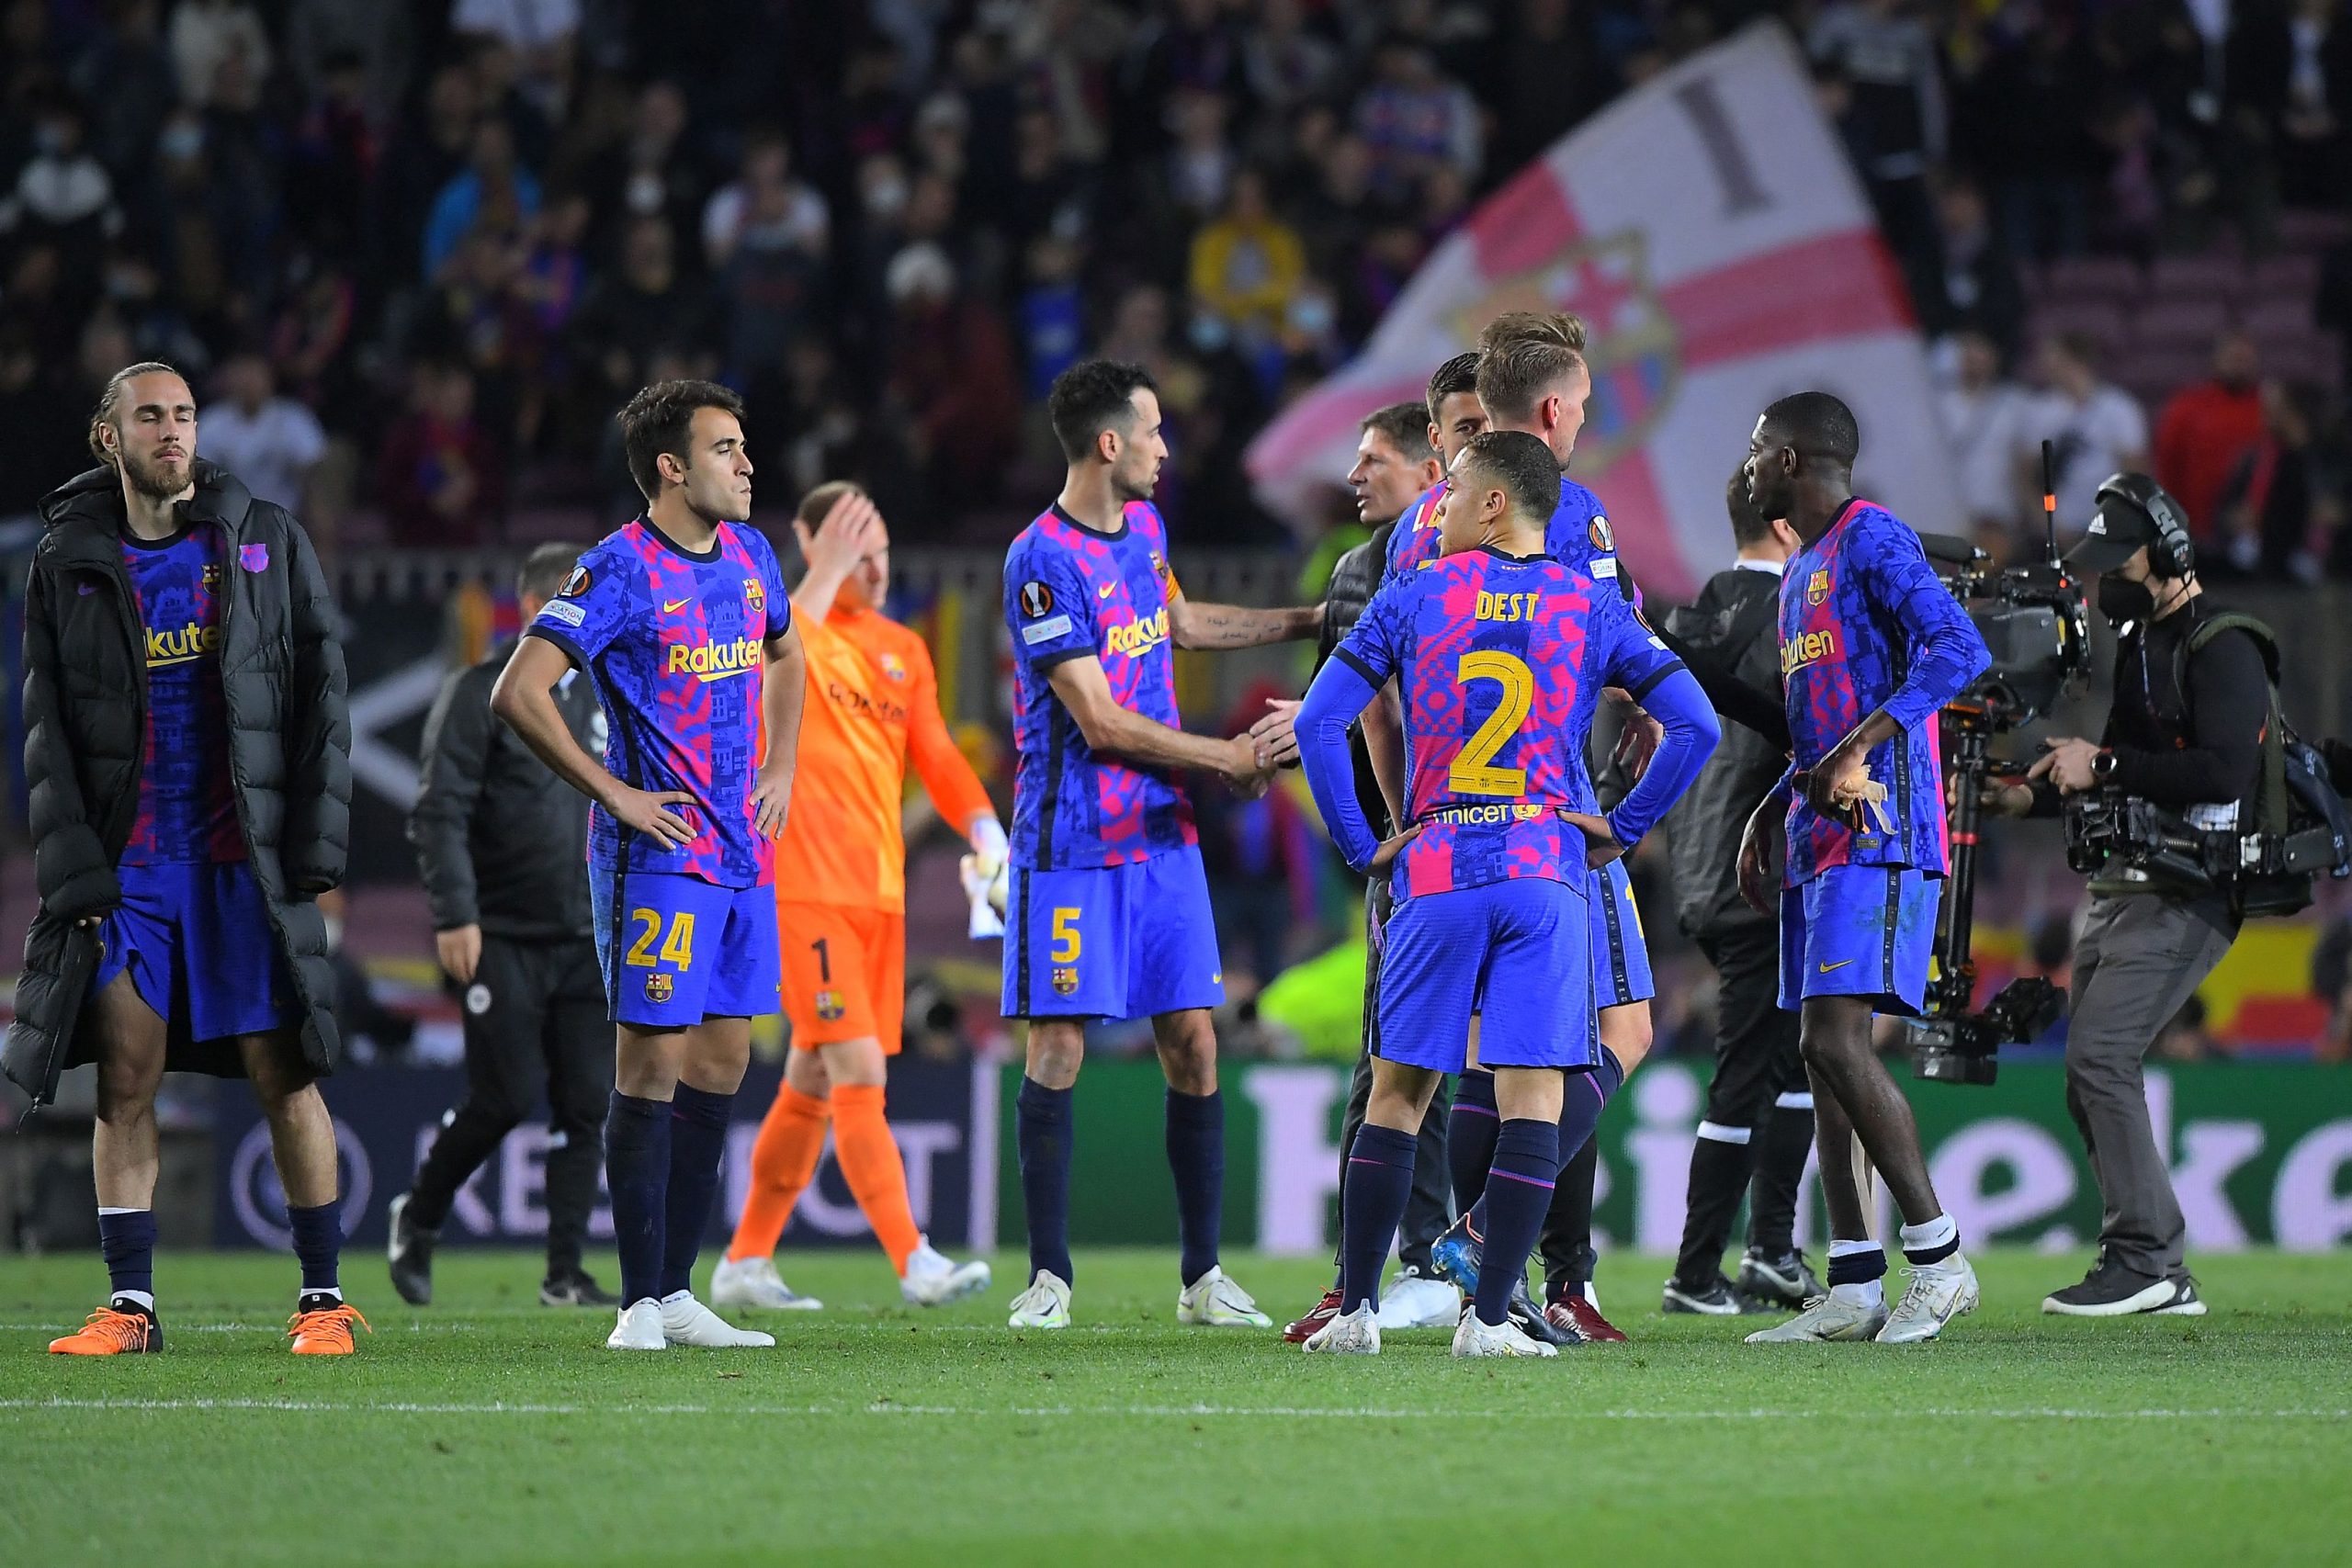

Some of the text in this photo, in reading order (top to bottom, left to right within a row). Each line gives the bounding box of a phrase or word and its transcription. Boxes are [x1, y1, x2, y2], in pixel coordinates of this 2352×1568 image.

[1475, 590, 1540, 622] DEST
[1448, 650, 1534, 796] 2
[626, 908, 695, 972] 24
[811, 938, 831, 983] 1
[1051, 907, 1081, 963] 5
